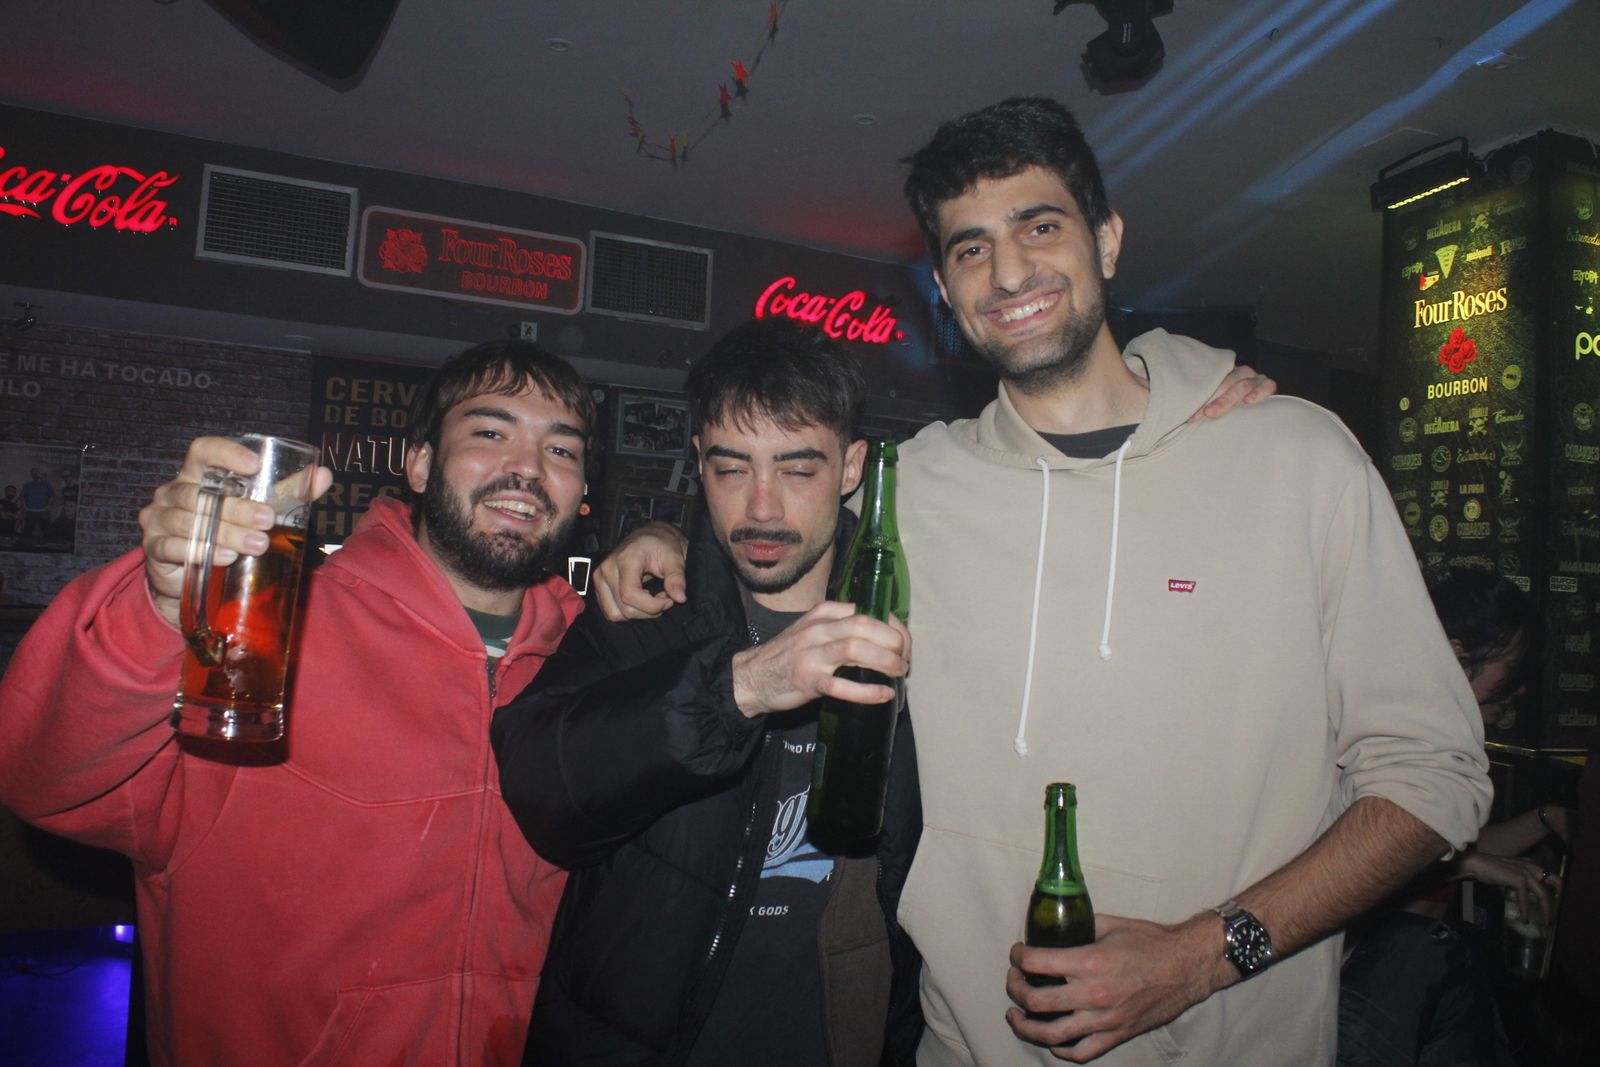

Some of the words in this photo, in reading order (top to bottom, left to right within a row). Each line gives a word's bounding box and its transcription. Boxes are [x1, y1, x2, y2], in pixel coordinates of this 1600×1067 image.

[0, 146, 179, 232] ca-Cola
[438, 228, 498, 269] Four
[499, 237, 573, 281] Roses
[460, 271, 549, 300] BOURBON
[755, 276, 896, 343] Coca-Cola
[1413, 299, 1452, 329] Four
[1452, 287, 1508, 322] Roses
[17, 354, 50, 373] ME
[60, 358, 97, 378] HA
[103, 363, 211, 389] TOCADO
[0, 378, 41, 398] LO
[1427, 376, 1488, 400] BOURBON
[324, 404, 360, 426] DE
[758, 905, 789, 916] GODS
